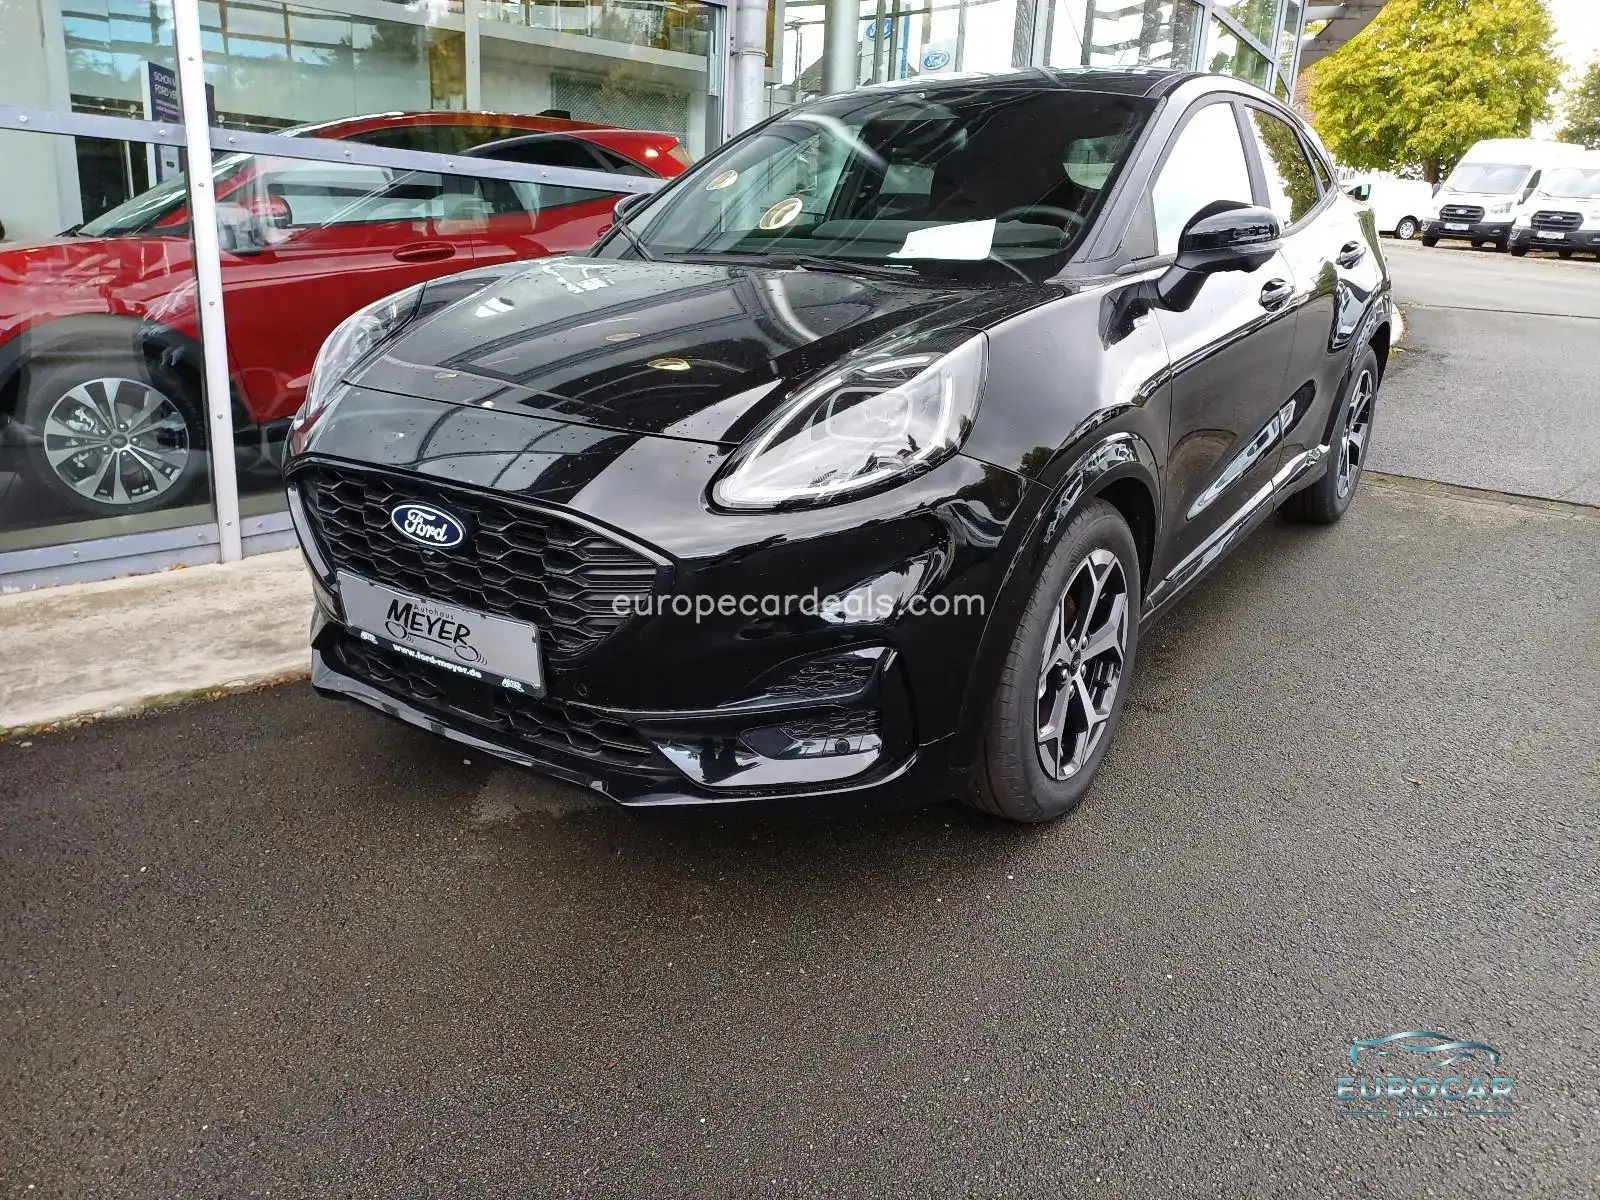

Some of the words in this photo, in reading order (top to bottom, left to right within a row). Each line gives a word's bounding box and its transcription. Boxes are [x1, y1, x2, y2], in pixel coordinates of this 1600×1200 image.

[404, 508, 448, 542] Ford
[386, 598, 471, 646] MEYER
[413, 603, 454, 620] Autohaus
[392, 643, 482, 679] www.ford-meyer.de
